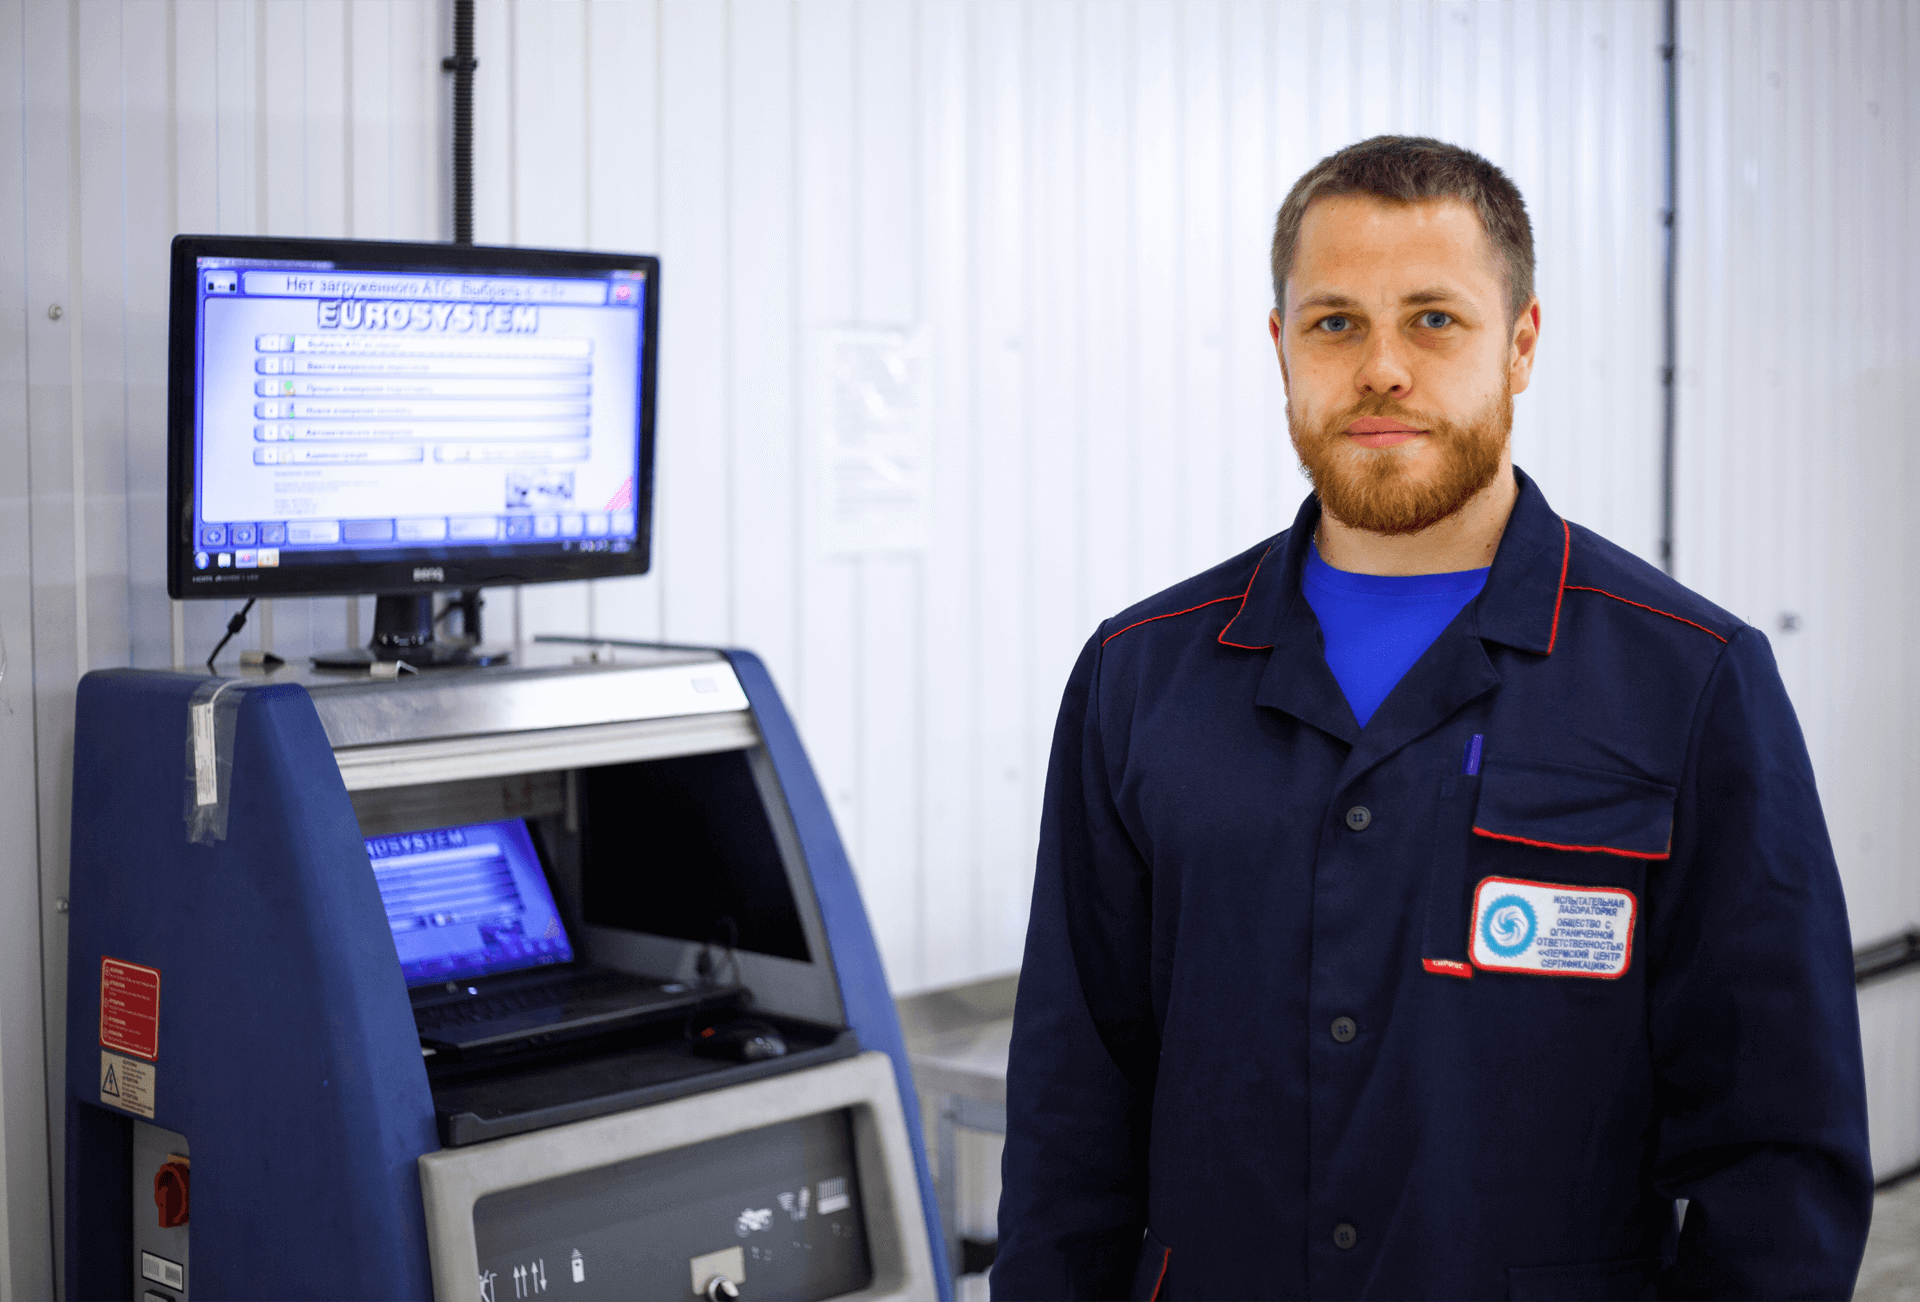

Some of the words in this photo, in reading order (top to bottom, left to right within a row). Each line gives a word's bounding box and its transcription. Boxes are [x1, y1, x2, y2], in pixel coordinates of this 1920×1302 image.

[286, 275, 315, 292] Нет
[318, 299, 540, 334] EUROSYSTEM
[1553, 895, 1625, 909] ИСПЫТАТЕЛЬНАЯ
[1558, 904, 1618, 917] ЛАБОРАТОРИЯ
[1556, 917, 1602, 929] ОБЩЕСТВО
[1549, 927, 1615, 941] ОГРАНИЧЕННОЙ
[1536, 937, 1625, 951] ОТВЕТСТВЕННОСТЬЮ
[1593, 950, 1622, 962] ЦЕНТР
